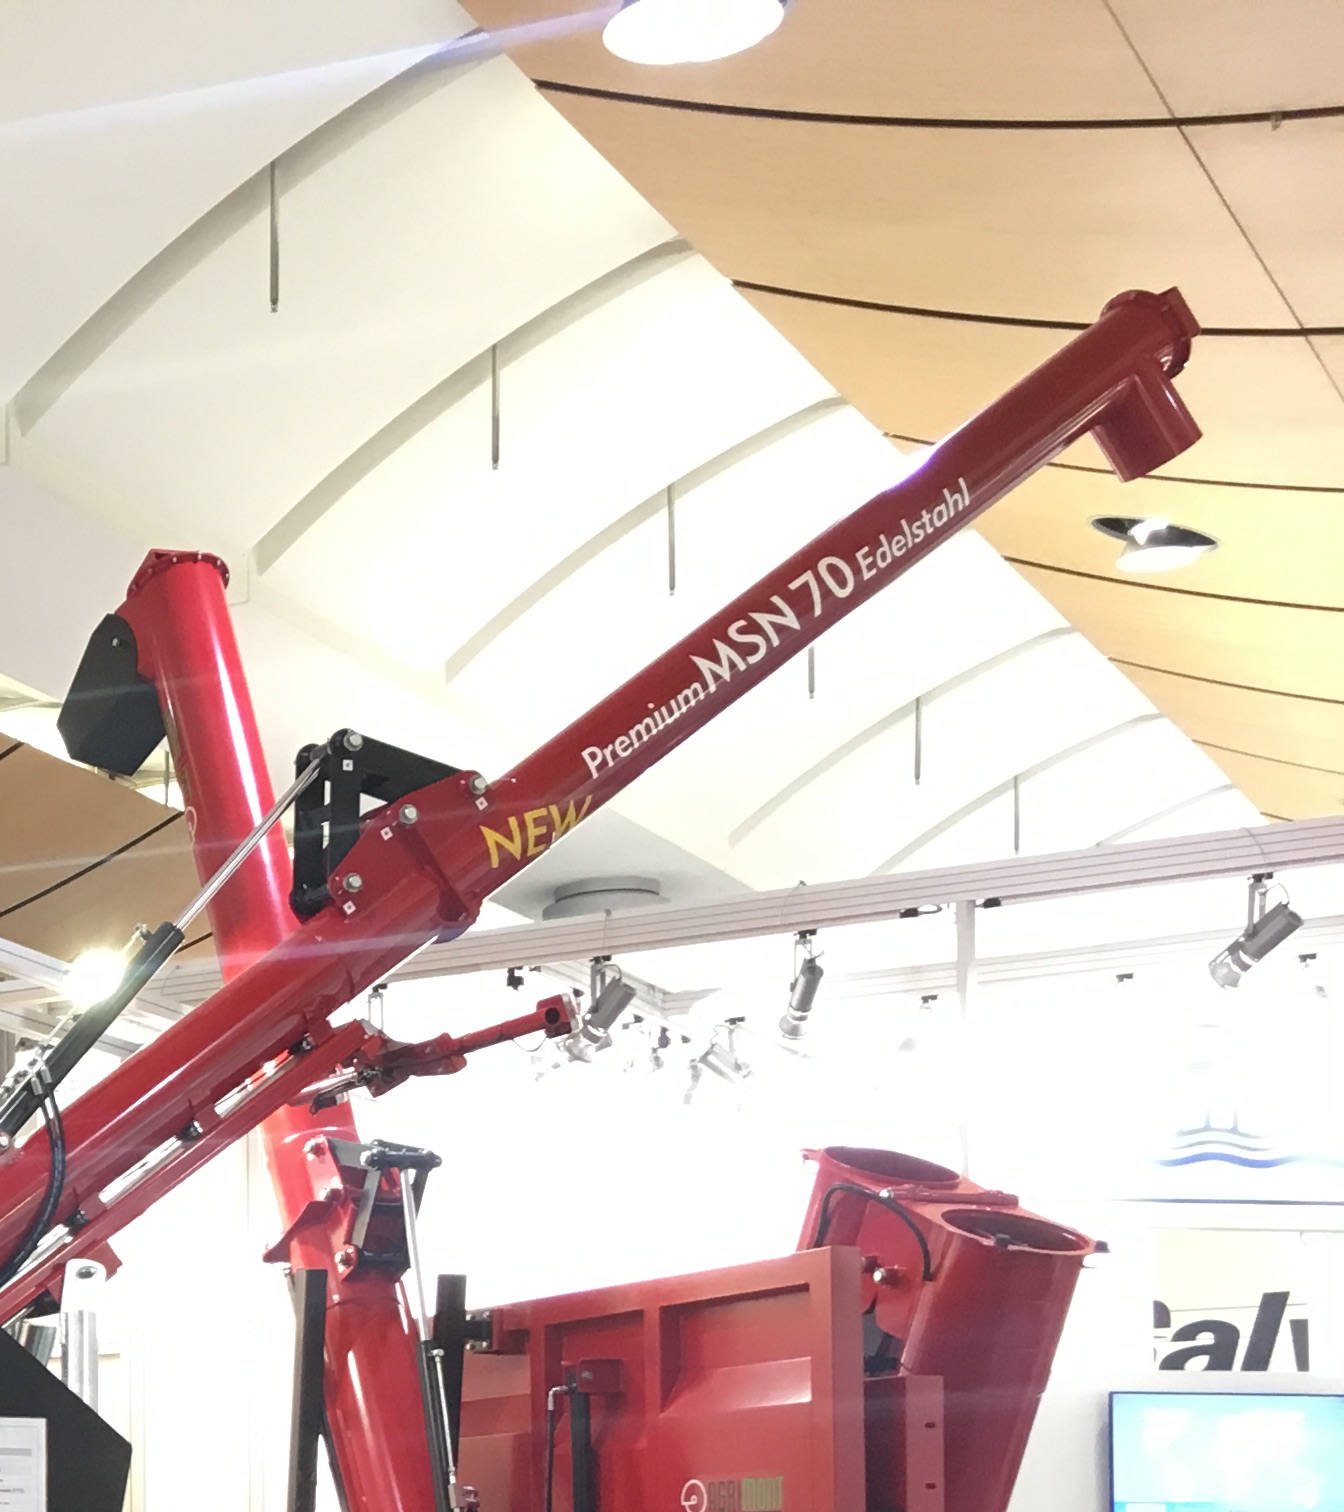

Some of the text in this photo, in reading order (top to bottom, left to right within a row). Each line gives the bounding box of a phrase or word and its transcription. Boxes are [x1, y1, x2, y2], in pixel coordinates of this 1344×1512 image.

[581, 476, 972, 779] Premium MSN 70 Edelstahl
[479, 795, 592, 868] NEW
